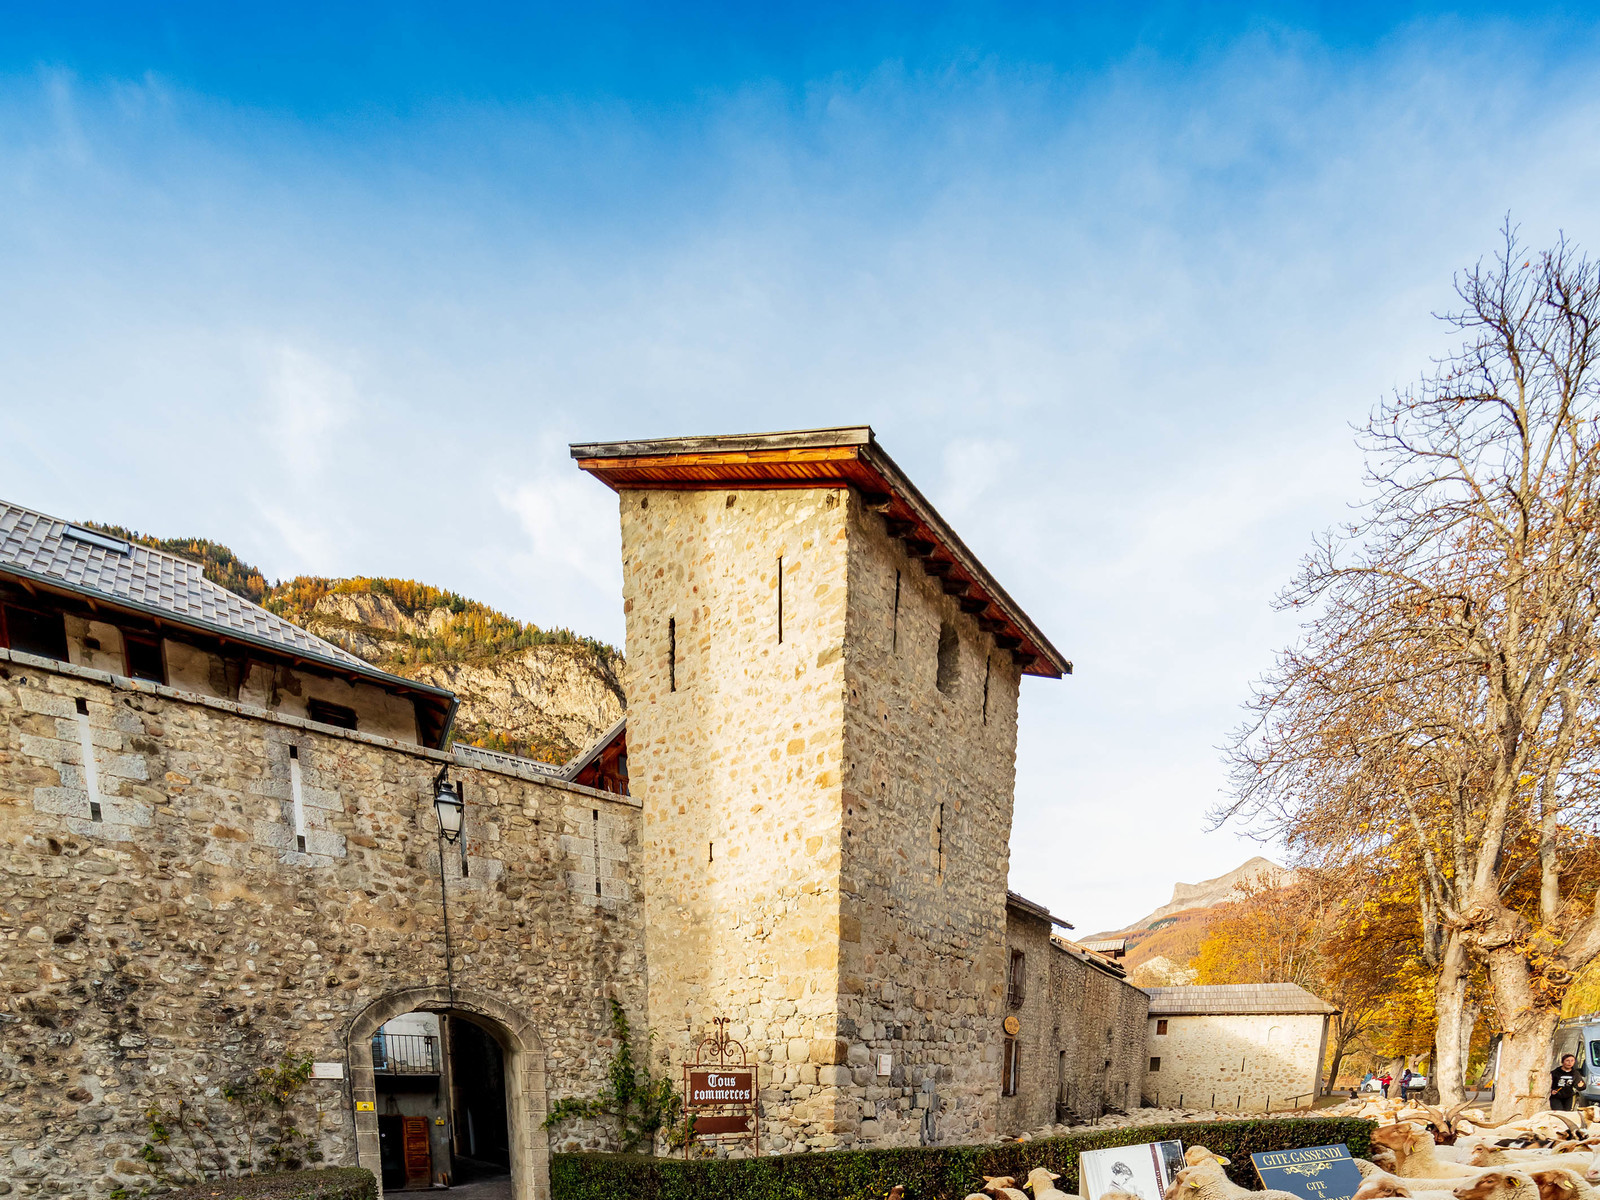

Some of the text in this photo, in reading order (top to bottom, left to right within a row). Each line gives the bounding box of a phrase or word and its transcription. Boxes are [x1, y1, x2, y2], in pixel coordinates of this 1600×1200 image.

[707, 1074, 736, 1088] Tous
[694, 1089, 750, 1100] commerces
[1262, 1147, 1343, 1166] GITE GASSENDI
[1306, 1181, 1328, 1191] GITE
